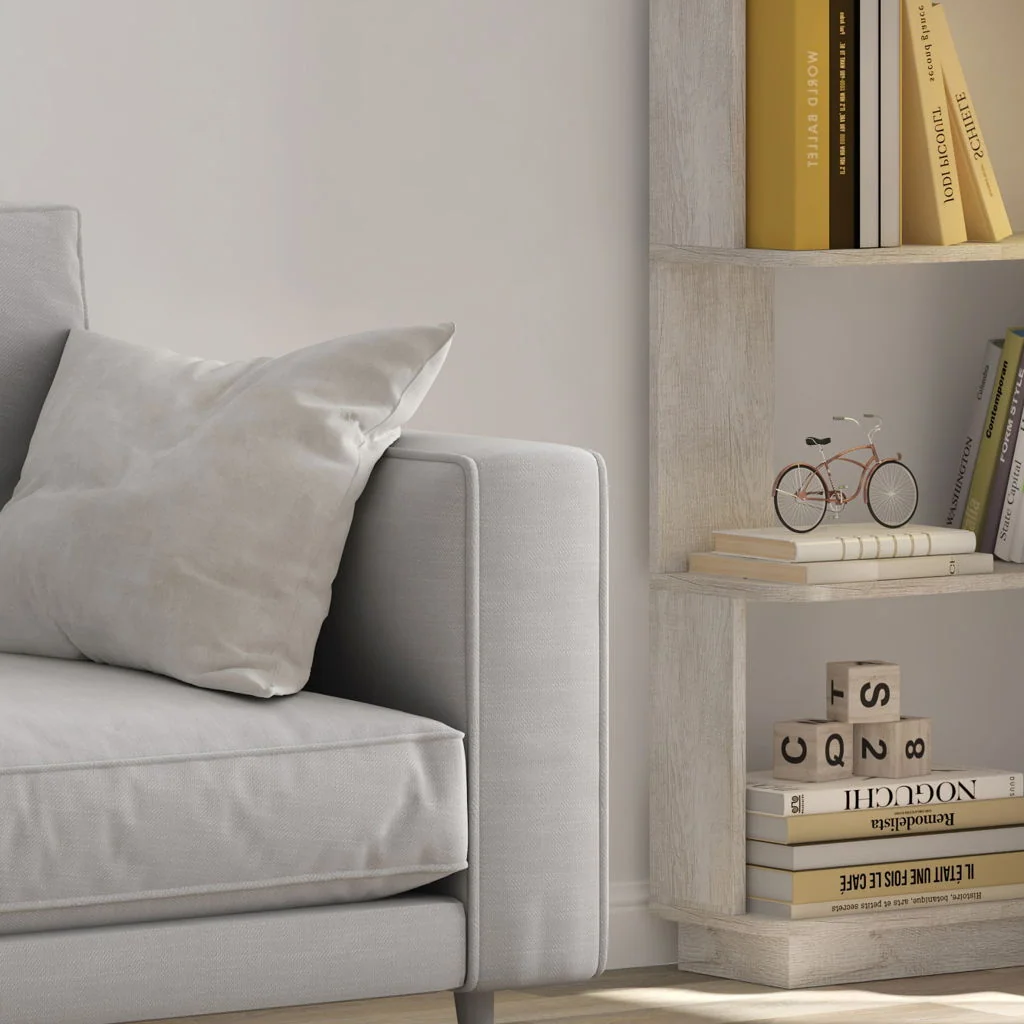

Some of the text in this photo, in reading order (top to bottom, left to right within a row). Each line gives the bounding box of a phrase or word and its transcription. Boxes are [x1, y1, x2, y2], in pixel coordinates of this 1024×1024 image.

[986, 360, 1009, 439] Contemporan
[1000, 367, 1024, 463] FORM STYLE
[946, 436, 973, 525] WASHINGTON
[999, 459, 1022, 542] State Capital
[860, 682, 890, 708] S
[781, 736, 807, 764] C
[825, 733, 845, 767] Q
[861, 737, 887, 760] 2
[905, 738, 925, 759] 8
[844, 779, 976, 810] NOGUCHI
[871, 812, 955, 832] Remodelista
[840, 863, 974, 895] IL ÉTAIT UNE FOIS LE CAFÉ
[832, 902, 858, 912] secrets
[861, 899, 882, 909] petits
[893, 898, 908, 906] arts
[912, 894, 948, 905] botanique,
[951, 891, 982, 902] Histoire,
